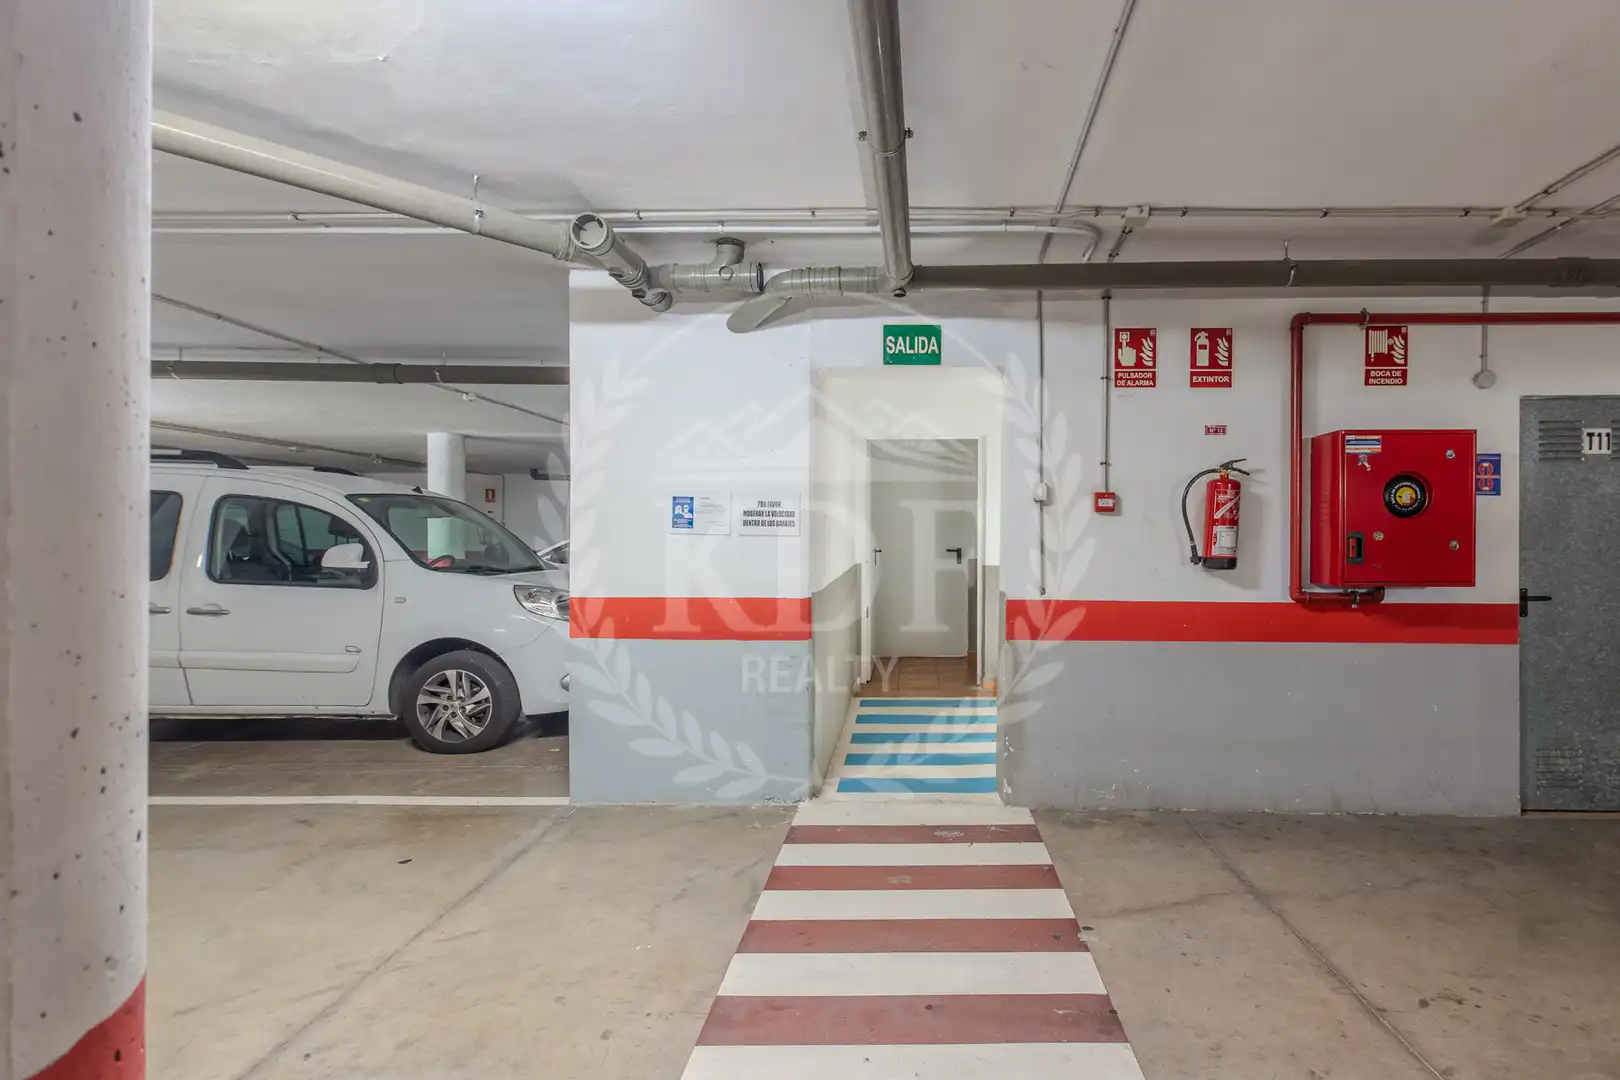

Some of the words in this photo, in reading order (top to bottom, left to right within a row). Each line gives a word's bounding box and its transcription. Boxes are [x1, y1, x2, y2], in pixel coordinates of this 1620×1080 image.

[885, 335, 939, 355] SALIDA
[1369, 370, 1389, 378] BOCA
[1390, 370, 1402, 378] DE
[1192, 375, 1230, 384] EXTINTOR
[1368, 377, 1403, 385] INCENDIO
[1586, 431, 1611, 451] T11
[743, 510, 764, 518] MODERAR
[771, 510, 795, 518] VELOCIDAD
